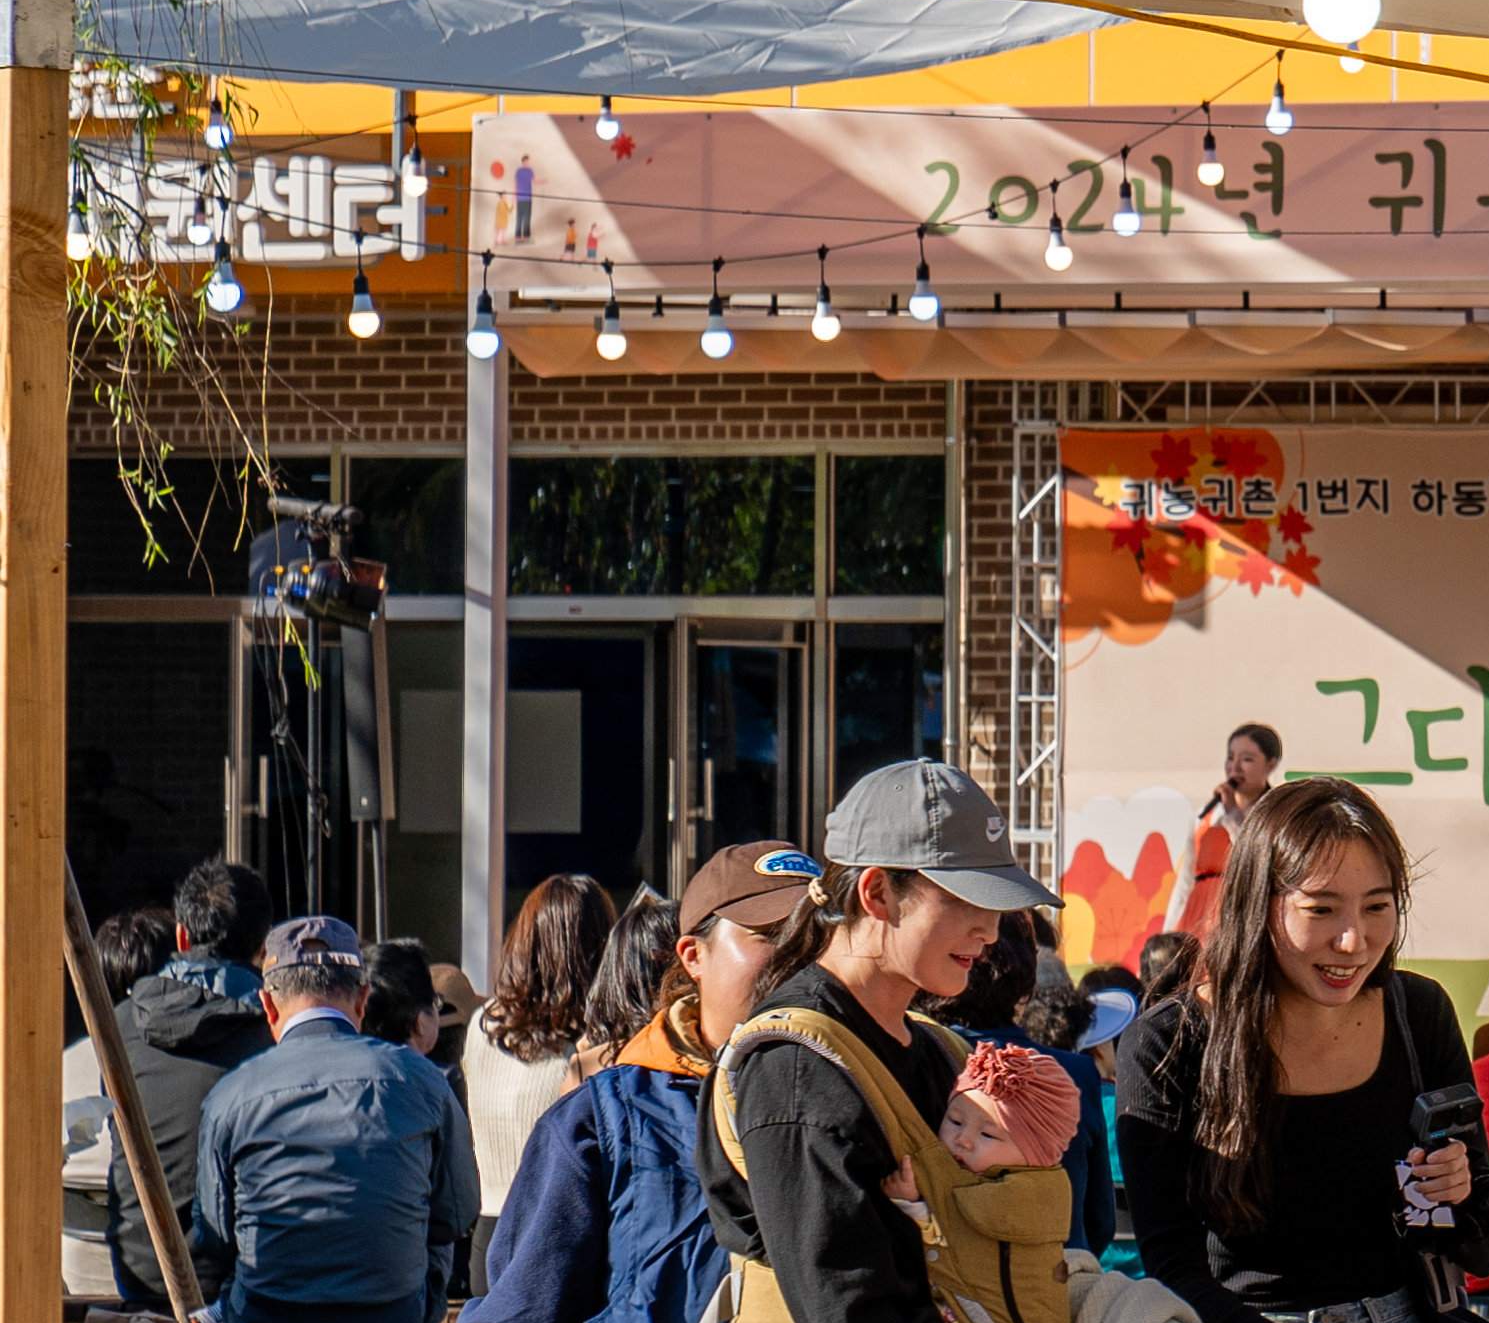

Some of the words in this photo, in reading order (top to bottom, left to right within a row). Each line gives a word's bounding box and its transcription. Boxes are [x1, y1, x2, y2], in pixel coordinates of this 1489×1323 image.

[922, 140, 1286, 241] 2024년
[1121, 478, 1277, 521] 귀농귀촌
[1295, 478, 1391, 516] 1번지
